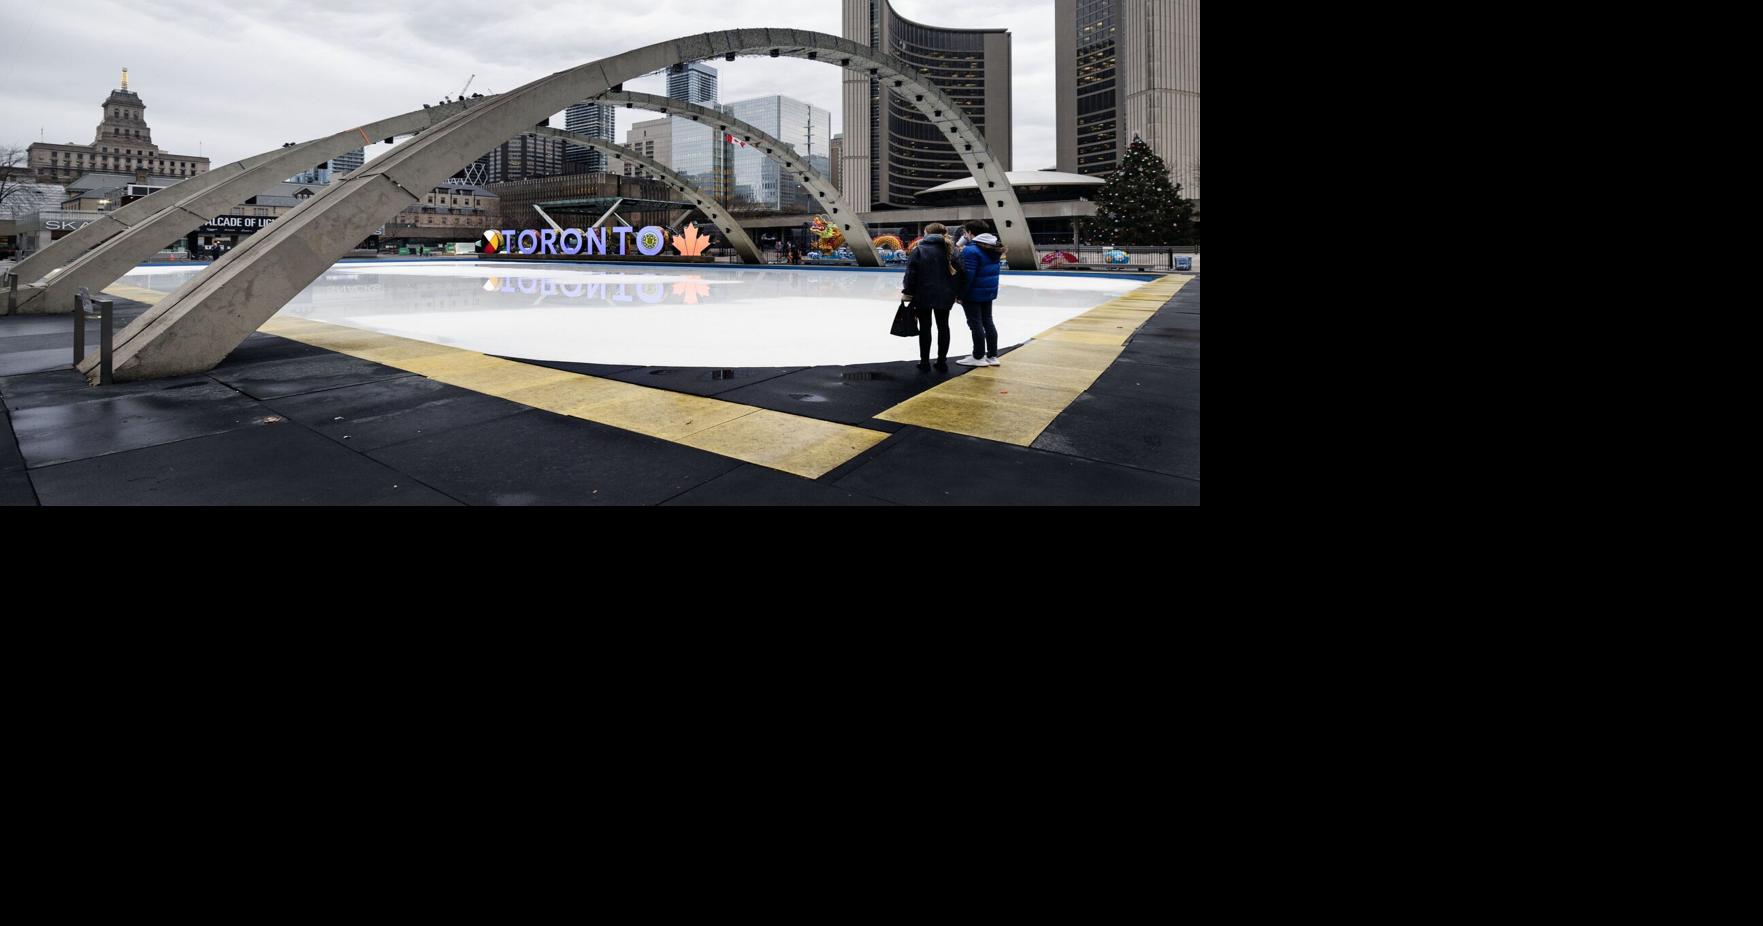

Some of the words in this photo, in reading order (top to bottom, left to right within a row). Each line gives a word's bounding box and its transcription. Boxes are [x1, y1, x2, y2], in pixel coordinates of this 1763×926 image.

[244, 218, 256, 227] OF
[258, 218, 274, 227] LIG
[502, 225, 664, 256] TORONTO
